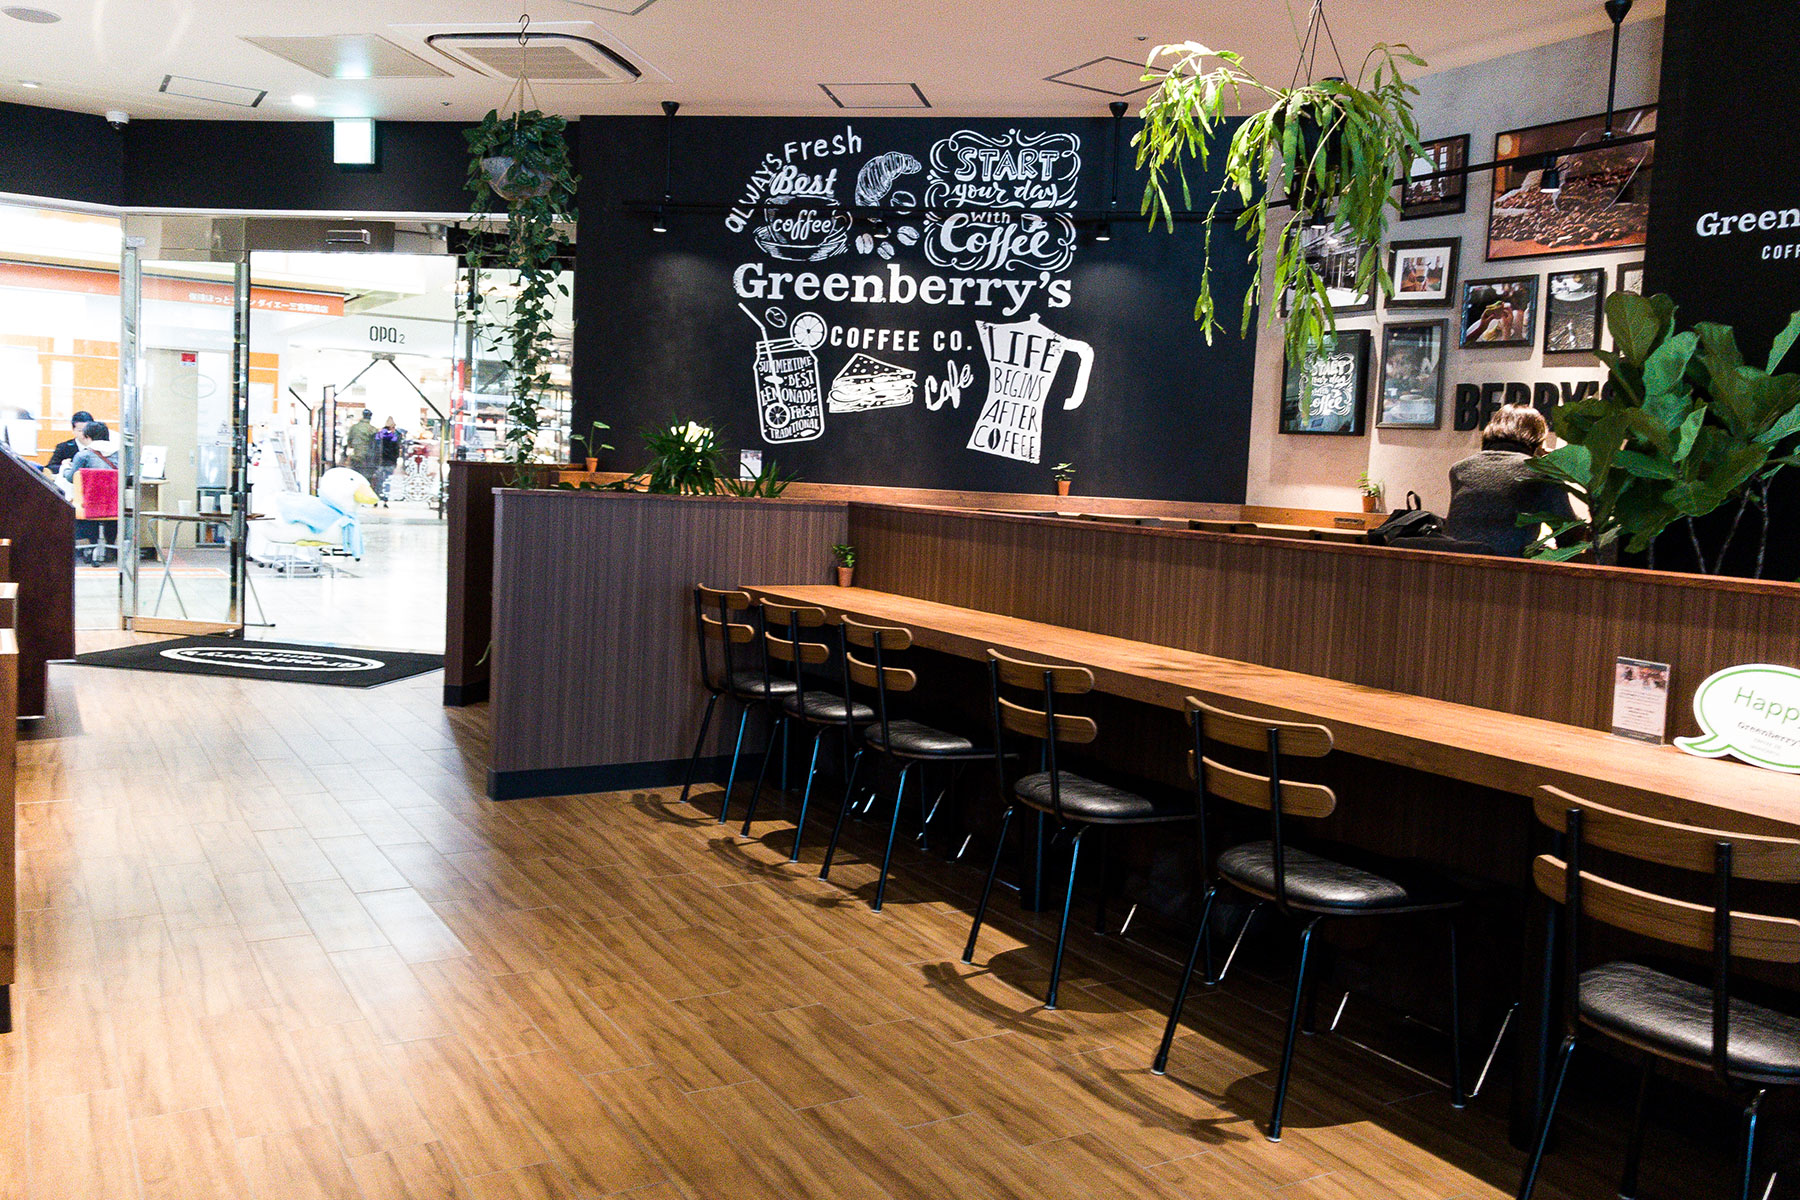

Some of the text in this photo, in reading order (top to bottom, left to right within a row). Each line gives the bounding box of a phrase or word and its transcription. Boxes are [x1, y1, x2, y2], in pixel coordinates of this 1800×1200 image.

[784, 125, 862, 163] Fresh
[770, 165, 838, 195] Best
[954, 147, 1060, 182] START
[951, 179, 1058, 208] your day
[773, 209, 832, 241] coffee
[940, 213, 1060, 271] Coffee
[733, 263, 1072, 317] Greenberry's
[830, 326, 973, 351] COFFEE CO.
[988, 326, 1061, 373] LIFE
[788, 370, 814, 388] BEST
[925, 359, 974, 411] Cafe
[994, 367, 1045, 402] BEGINS
[789, 404, 819, 419] FRESH
[982, 399, 1038, 432] AFTER
[973, 425, 1036, 460] COFFEE
[1734, 687, 1800, 724] Happ
